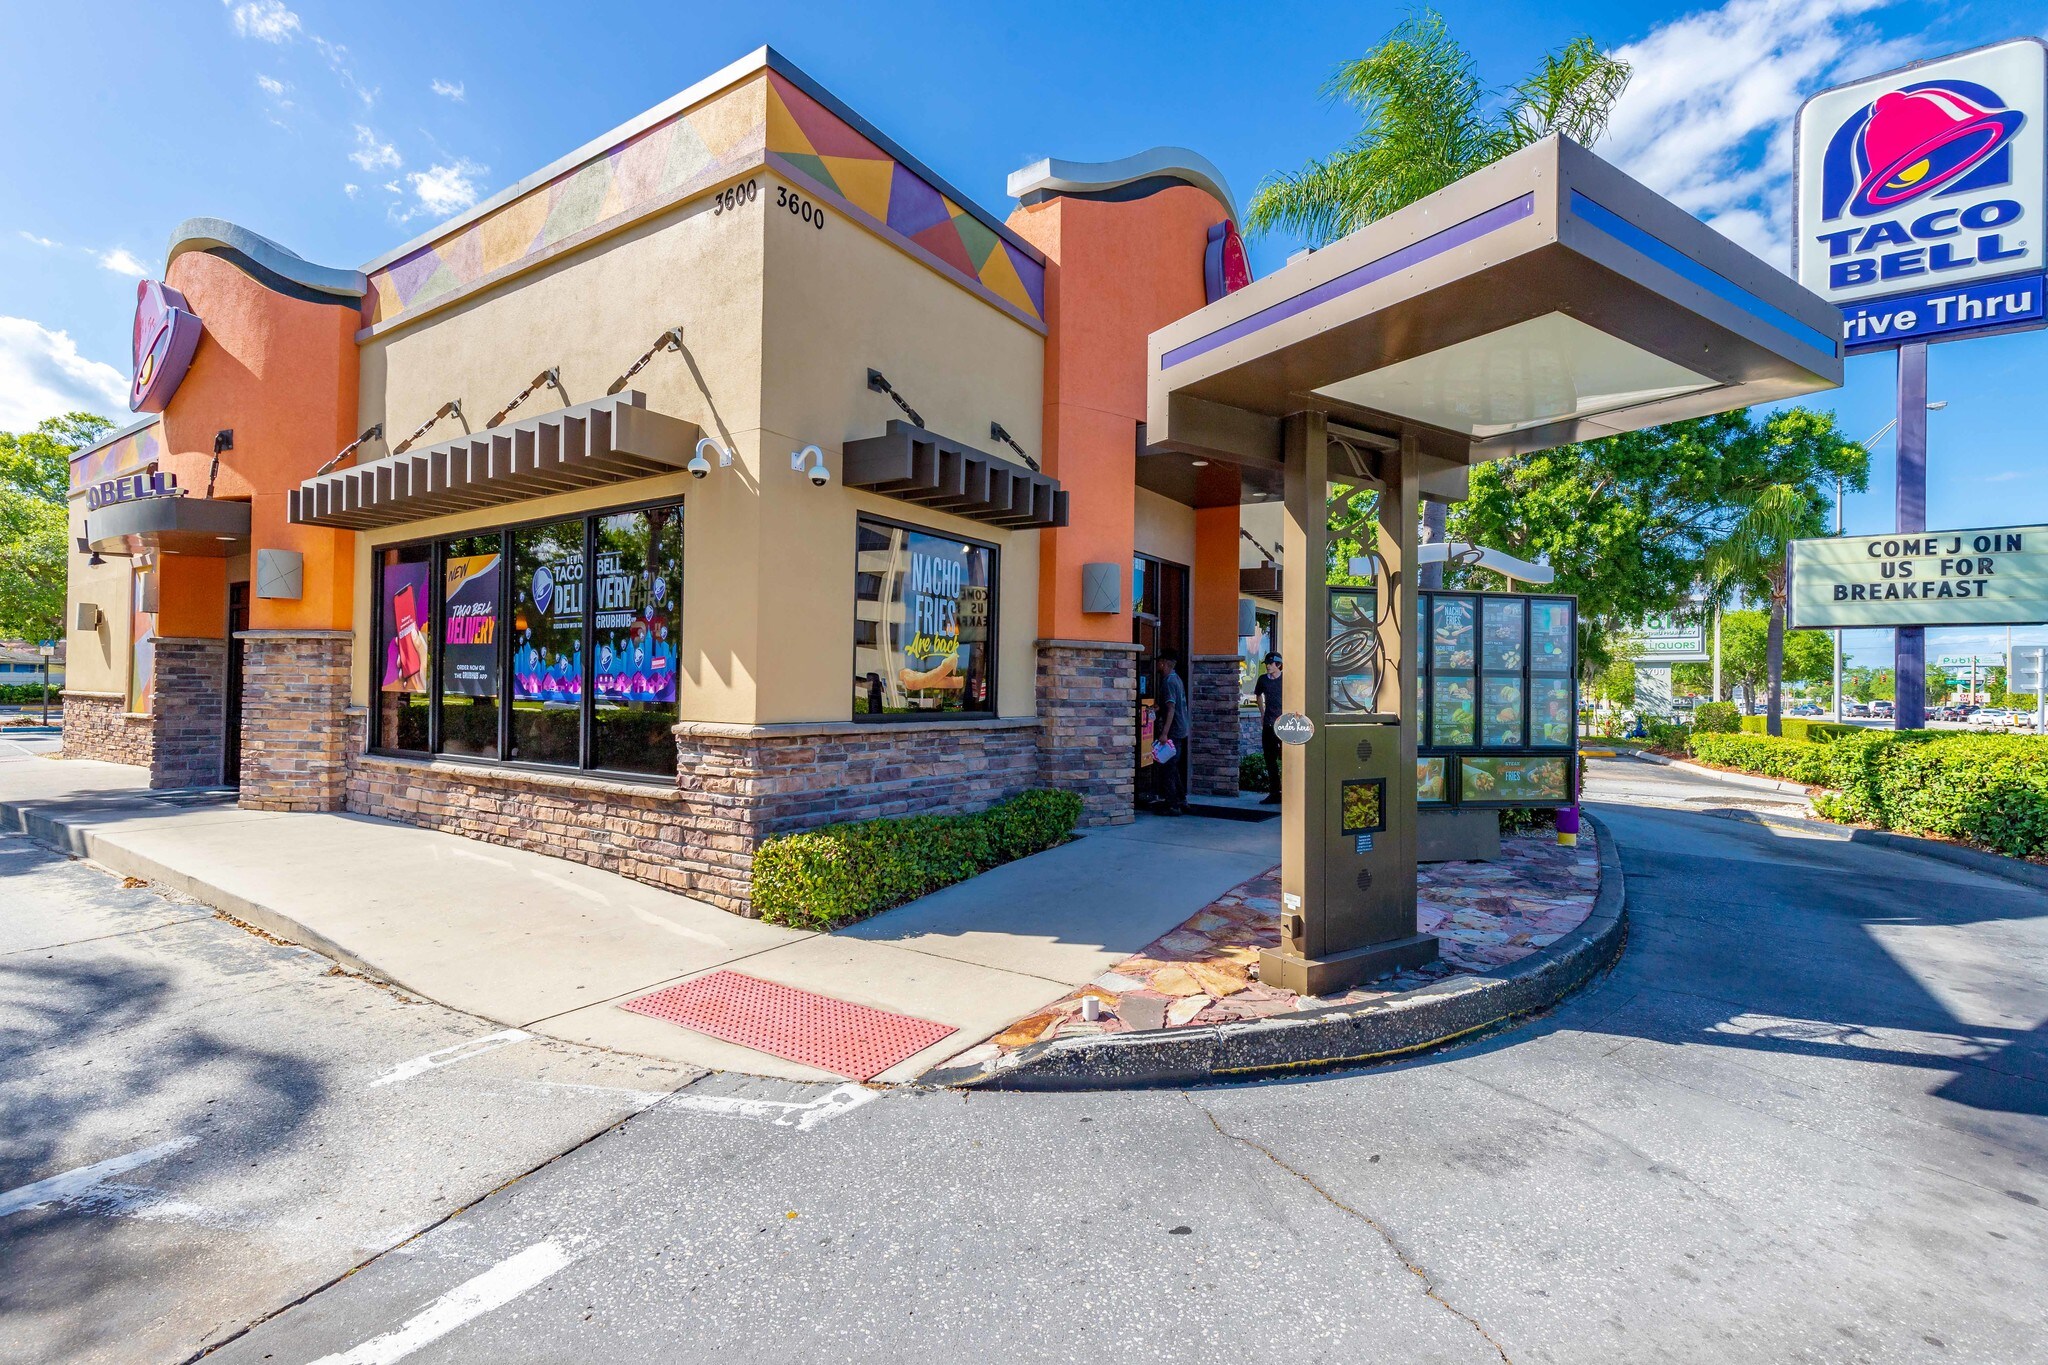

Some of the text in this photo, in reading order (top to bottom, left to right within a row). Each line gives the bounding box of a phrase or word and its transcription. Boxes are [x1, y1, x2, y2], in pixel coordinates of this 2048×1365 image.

[713, 179, 758, 217] 3600
[776, 185, 825, 230] 3600
[1815, 199, 2023, 259] TACO
[1829, 233, 2027, 290] BELL
[1843, 291, 2032, 339] rive Thru
[1867, 538, 1938, 558] COME
[448, 558, 471, 582] NEW
[553, 564, 583, 582] TACO
[596, 558, 624, 576] BELL
[912, 552, 960, 599] NACHO
[1880, 557, 1994, 579] US FOR
[1833, 579, 1989, 601] BREAKFAST
[453, 601, 493, 620] TACO BELL
[596, 614, 632, 629] GRUBHUB
[915, 594, 957, 638] FRIES
[1444, 606, 1463, 617] NACHO
[1445, 615, 1462, 626] FRIES
[446, 616, 496, 645] DELIVERY
[905, 630, 960, 659] Are back
[1650, 641, 1696, 650] LIQUORS
[1277, 721, 1312, 732] order here
[1505, 771, 1521, 782] FRIES
